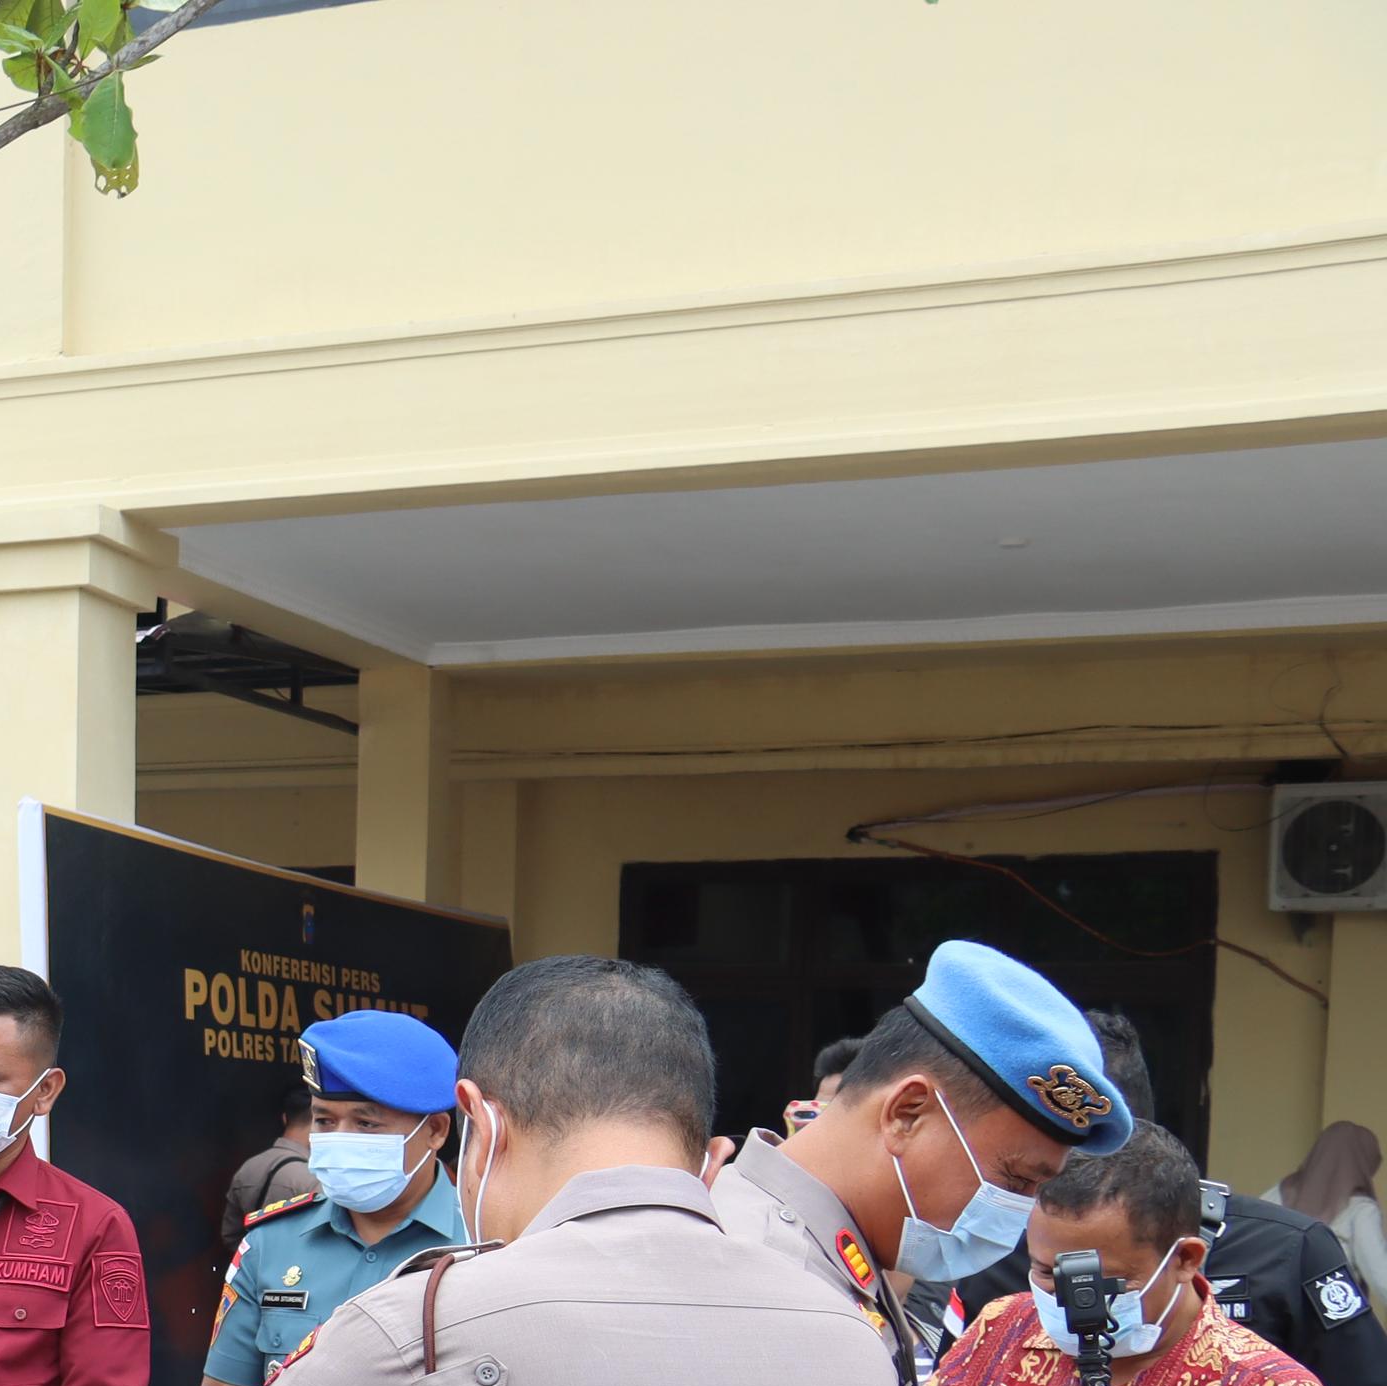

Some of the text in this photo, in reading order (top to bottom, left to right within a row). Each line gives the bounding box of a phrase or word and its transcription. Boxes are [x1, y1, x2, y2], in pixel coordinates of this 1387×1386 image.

[240, 949, 381, 993] KONFERENSI PERS
[184, 967, 301, 1034] POLDA
[204, 1028, 275, 1062] POLRES
[1233, 1303, 1246, 1318] RI
